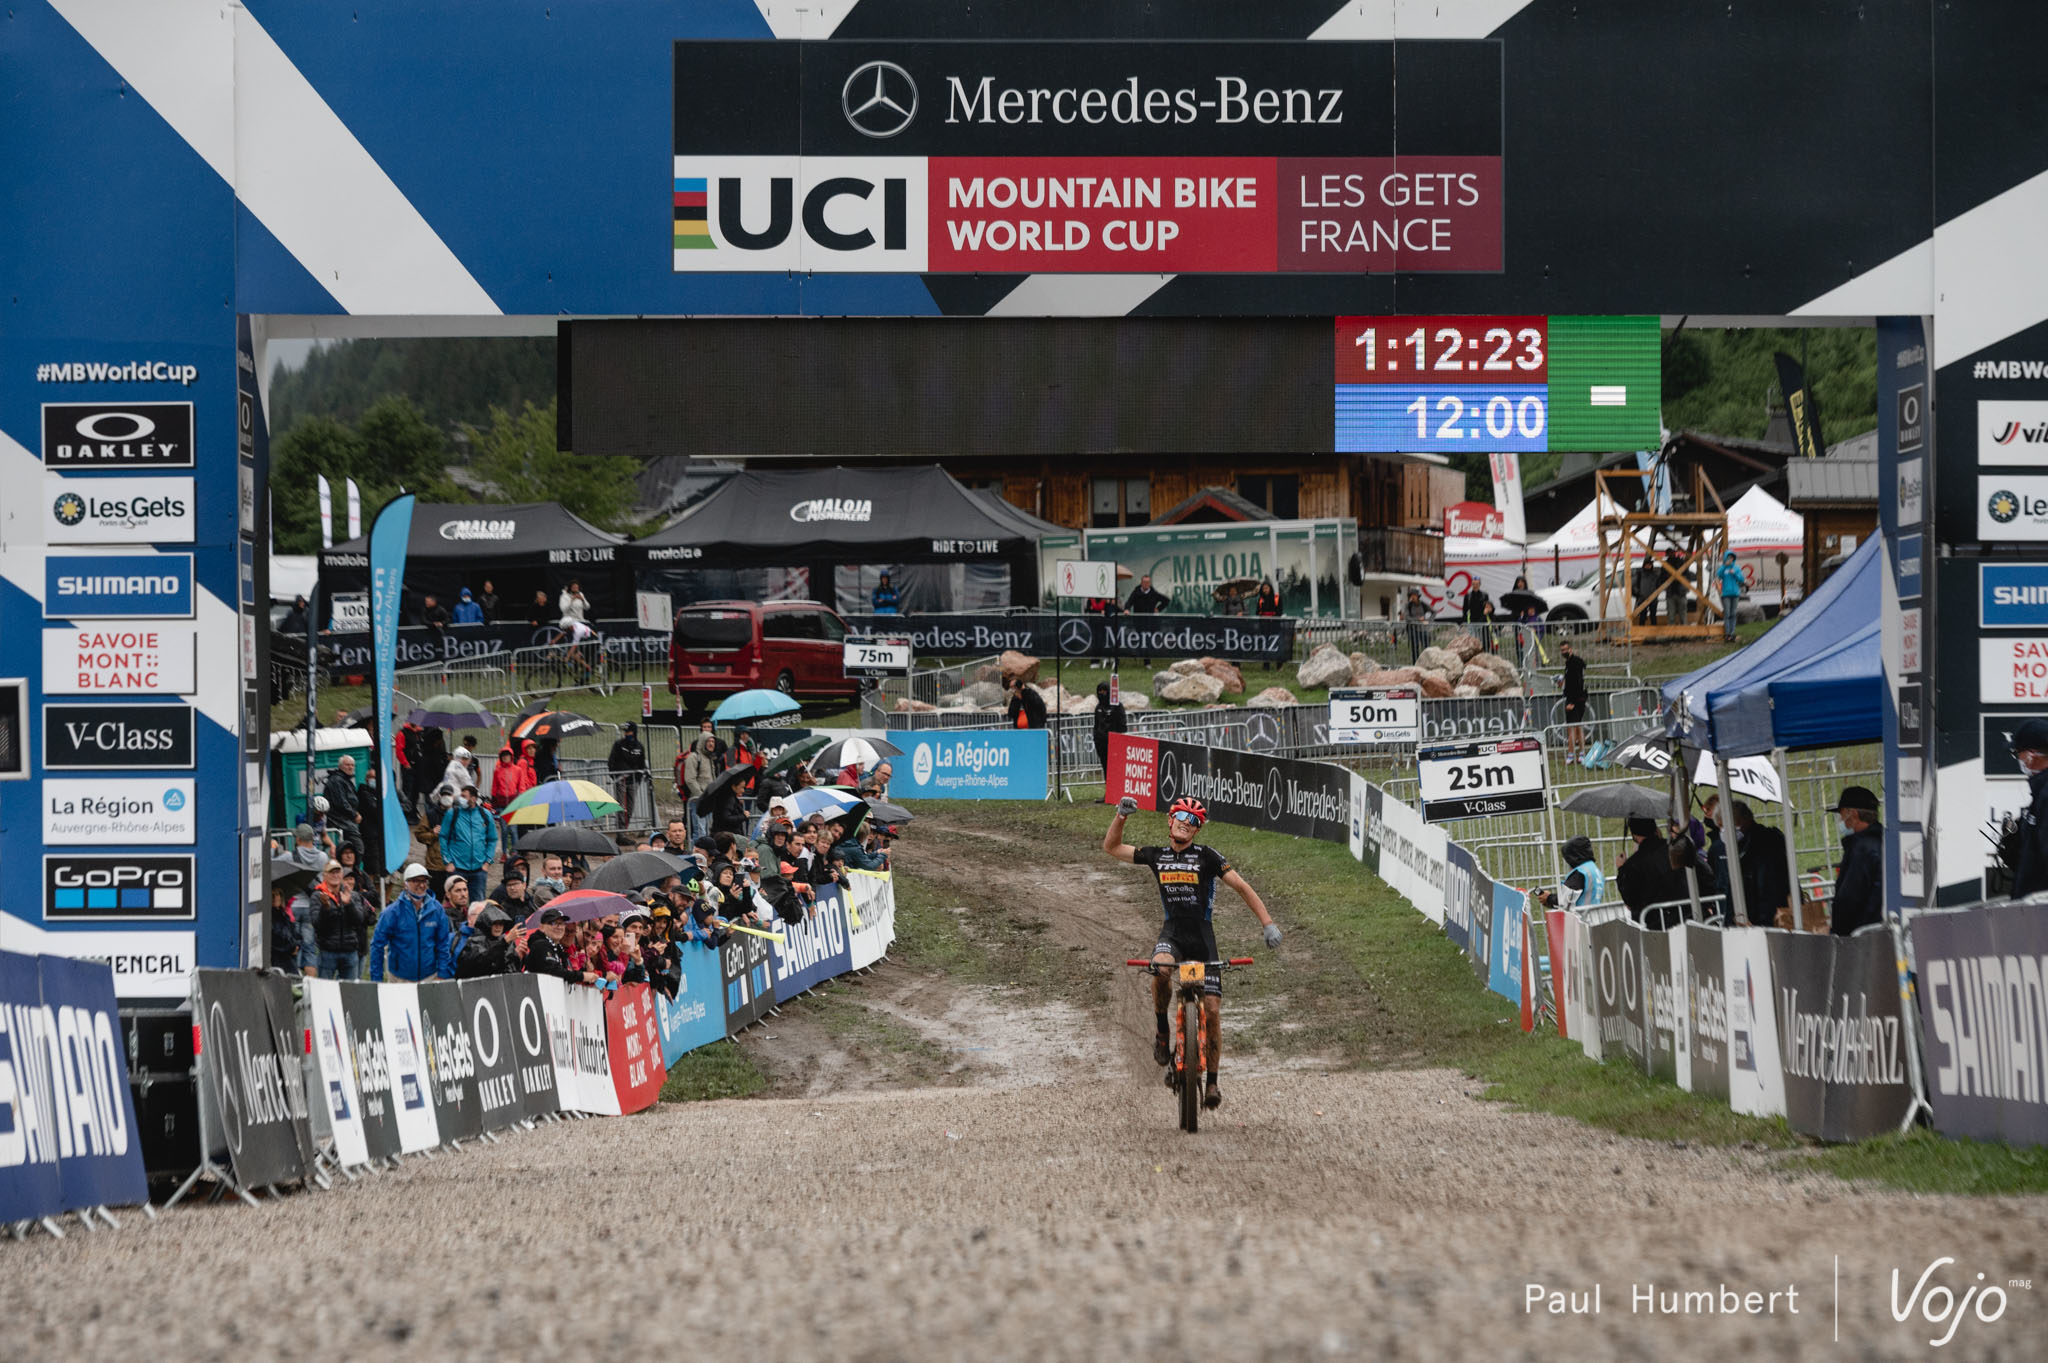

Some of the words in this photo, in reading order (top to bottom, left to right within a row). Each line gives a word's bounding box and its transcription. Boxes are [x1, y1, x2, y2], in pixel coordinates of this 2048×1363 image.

[944, 76, 1344, 124] Mercedes-Benz
[948, 178, 1162, 208] MOUNTAIN
[1174, 178, 1257, 208] BIKE
[1300, 174, 1365, 208] LES
[1380, 172, 1479, 207] GETS
[718, 177, 907, 252] UCI
[947, 220, 1091, 251] WORLD
[1102, 220, 1180, 251] CUP
[1300, 218, 1451, 253] FRANCE
[1355, 327, 1544, 370] 1:12:23
[36, 360, 198, 385] #MBWorldCup
[1406, 396, 1544, 438] 12:00
[57, 444, 175, 458] OAKLEY
[809, 498, 872, 513] MALOJA
[549, 549, 573, 563] RIDE
[592, 547, 615, 561] LIVE
[932, 539, 957, 554] RIDE
[976, 538, 999, 553] LIVE
[1172, 551, 1263, 583] MALOJA
[58, 576, 179, 595] SHIMANO
[78, 632, 159, 649] SAVOIE
[1104, 625, 1280, 652] Mercedes-Benz
[78, 653, 140, 669] MONT
[859, 649, 893, 663] 75m
[78, 672, 159, 689] BLANC
[1350, 705, 1397, 723] 50m
[65, 722, 174, 750] V-Class
[935, 742, 953, 767] La
[956, 741, 1010, 772] Région
[1126, 745, 1153, 763] SAVOIE
[1480, 745, 1496, 753] UCI
[1618, 744, 1672, 770] PING
[935, 774, 1009, 789] Auvergne-Rhône-Alpes
[1125, 763, 1147, 779] MONT
[1448, 763, 1515, 791] 25m
[1124, 779, 1152, 797] BLANC
[1181, 762, 1264, 809] Mercedes-Benz
[51, 798, 75, 815] La
[81, 797, 154, 818] Région
[1463, 799, 1506, 814] V-Class
[51, 821, 185, 834] Auvergne-Rhône-Alpes
[54, 866, 184, 887] GoPro
[1156, 862, 1201, 871] TREK
[726, 943, 745, 978] GoPro
[1188, 967, 1196, 978] 4
[478, 1073, 517, 1113] OAKLEY
